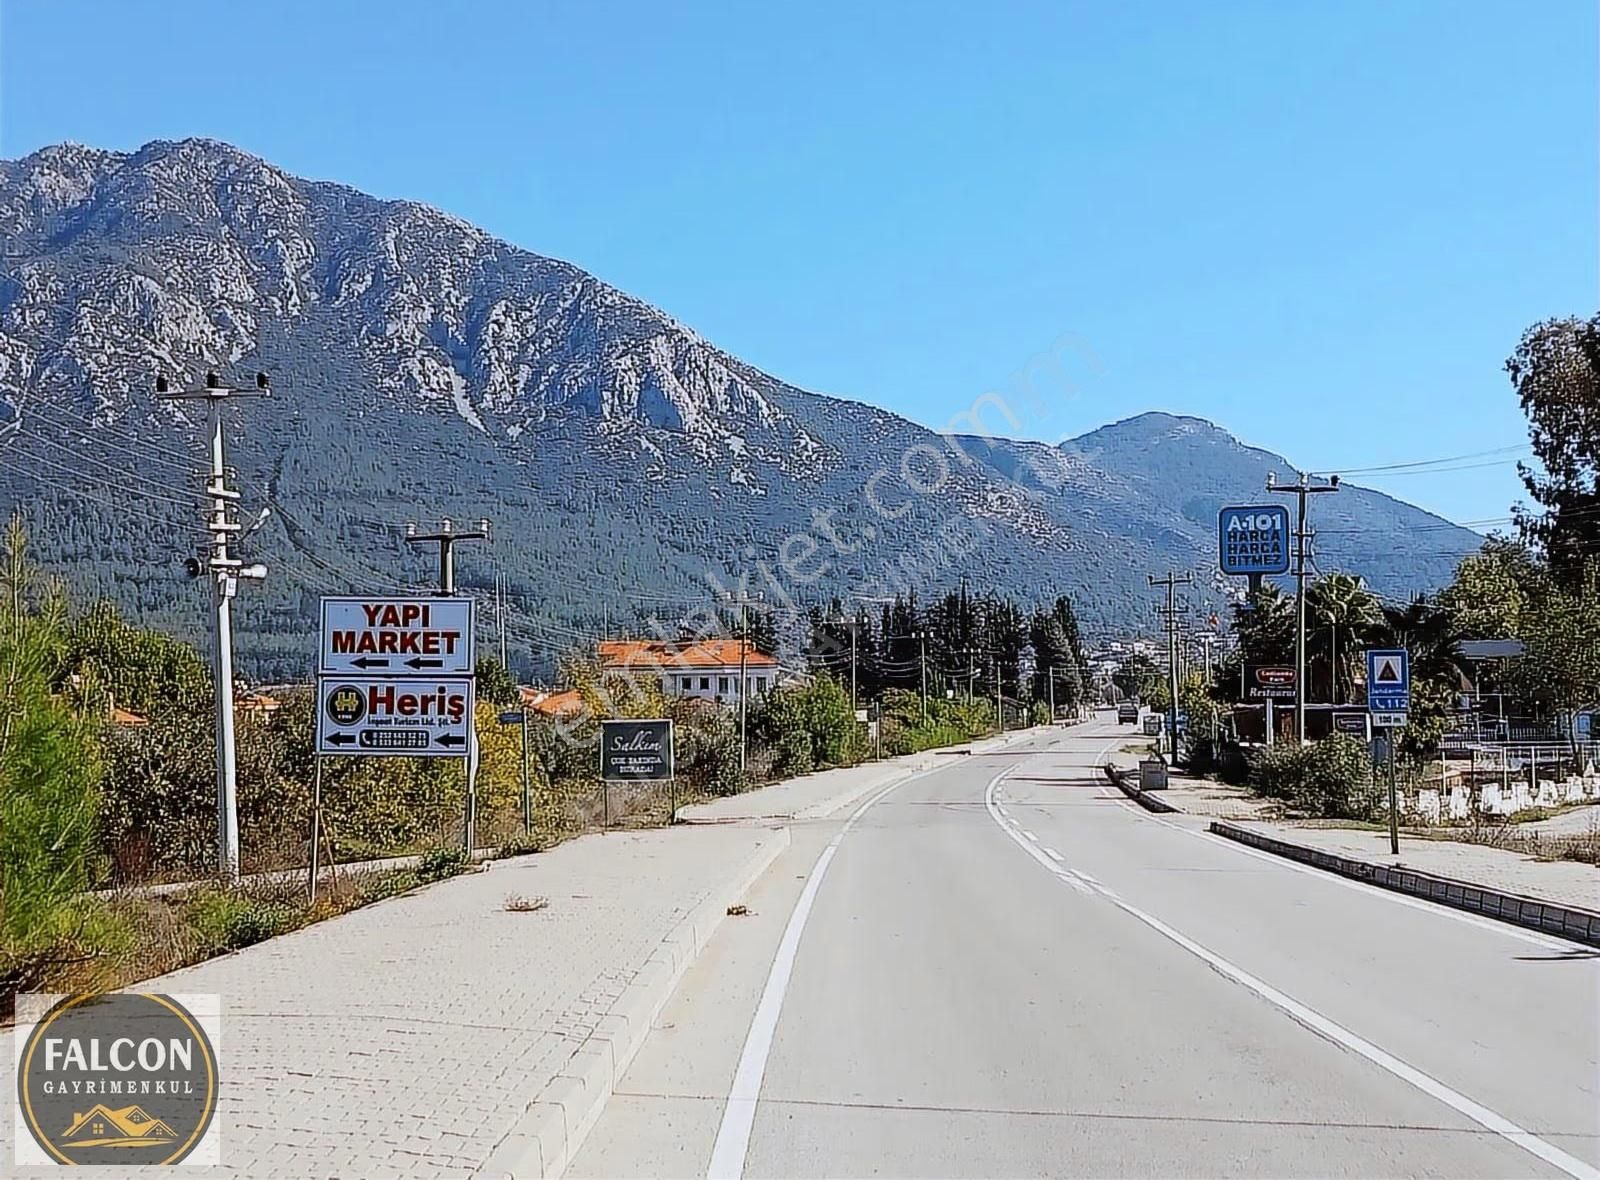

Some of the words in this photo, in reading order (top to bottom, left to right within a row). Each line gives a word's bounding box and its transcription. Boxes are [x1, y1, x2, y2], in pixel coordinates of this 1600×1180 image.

[1227, 531, 1281, 542] HARCA
[1227, 543, 1281, 554] HARCA
[362, 604, 430, 628] YAPI
[332, 631, 460, 655] MARKET
[1387, 698, 1408, 709] 112
